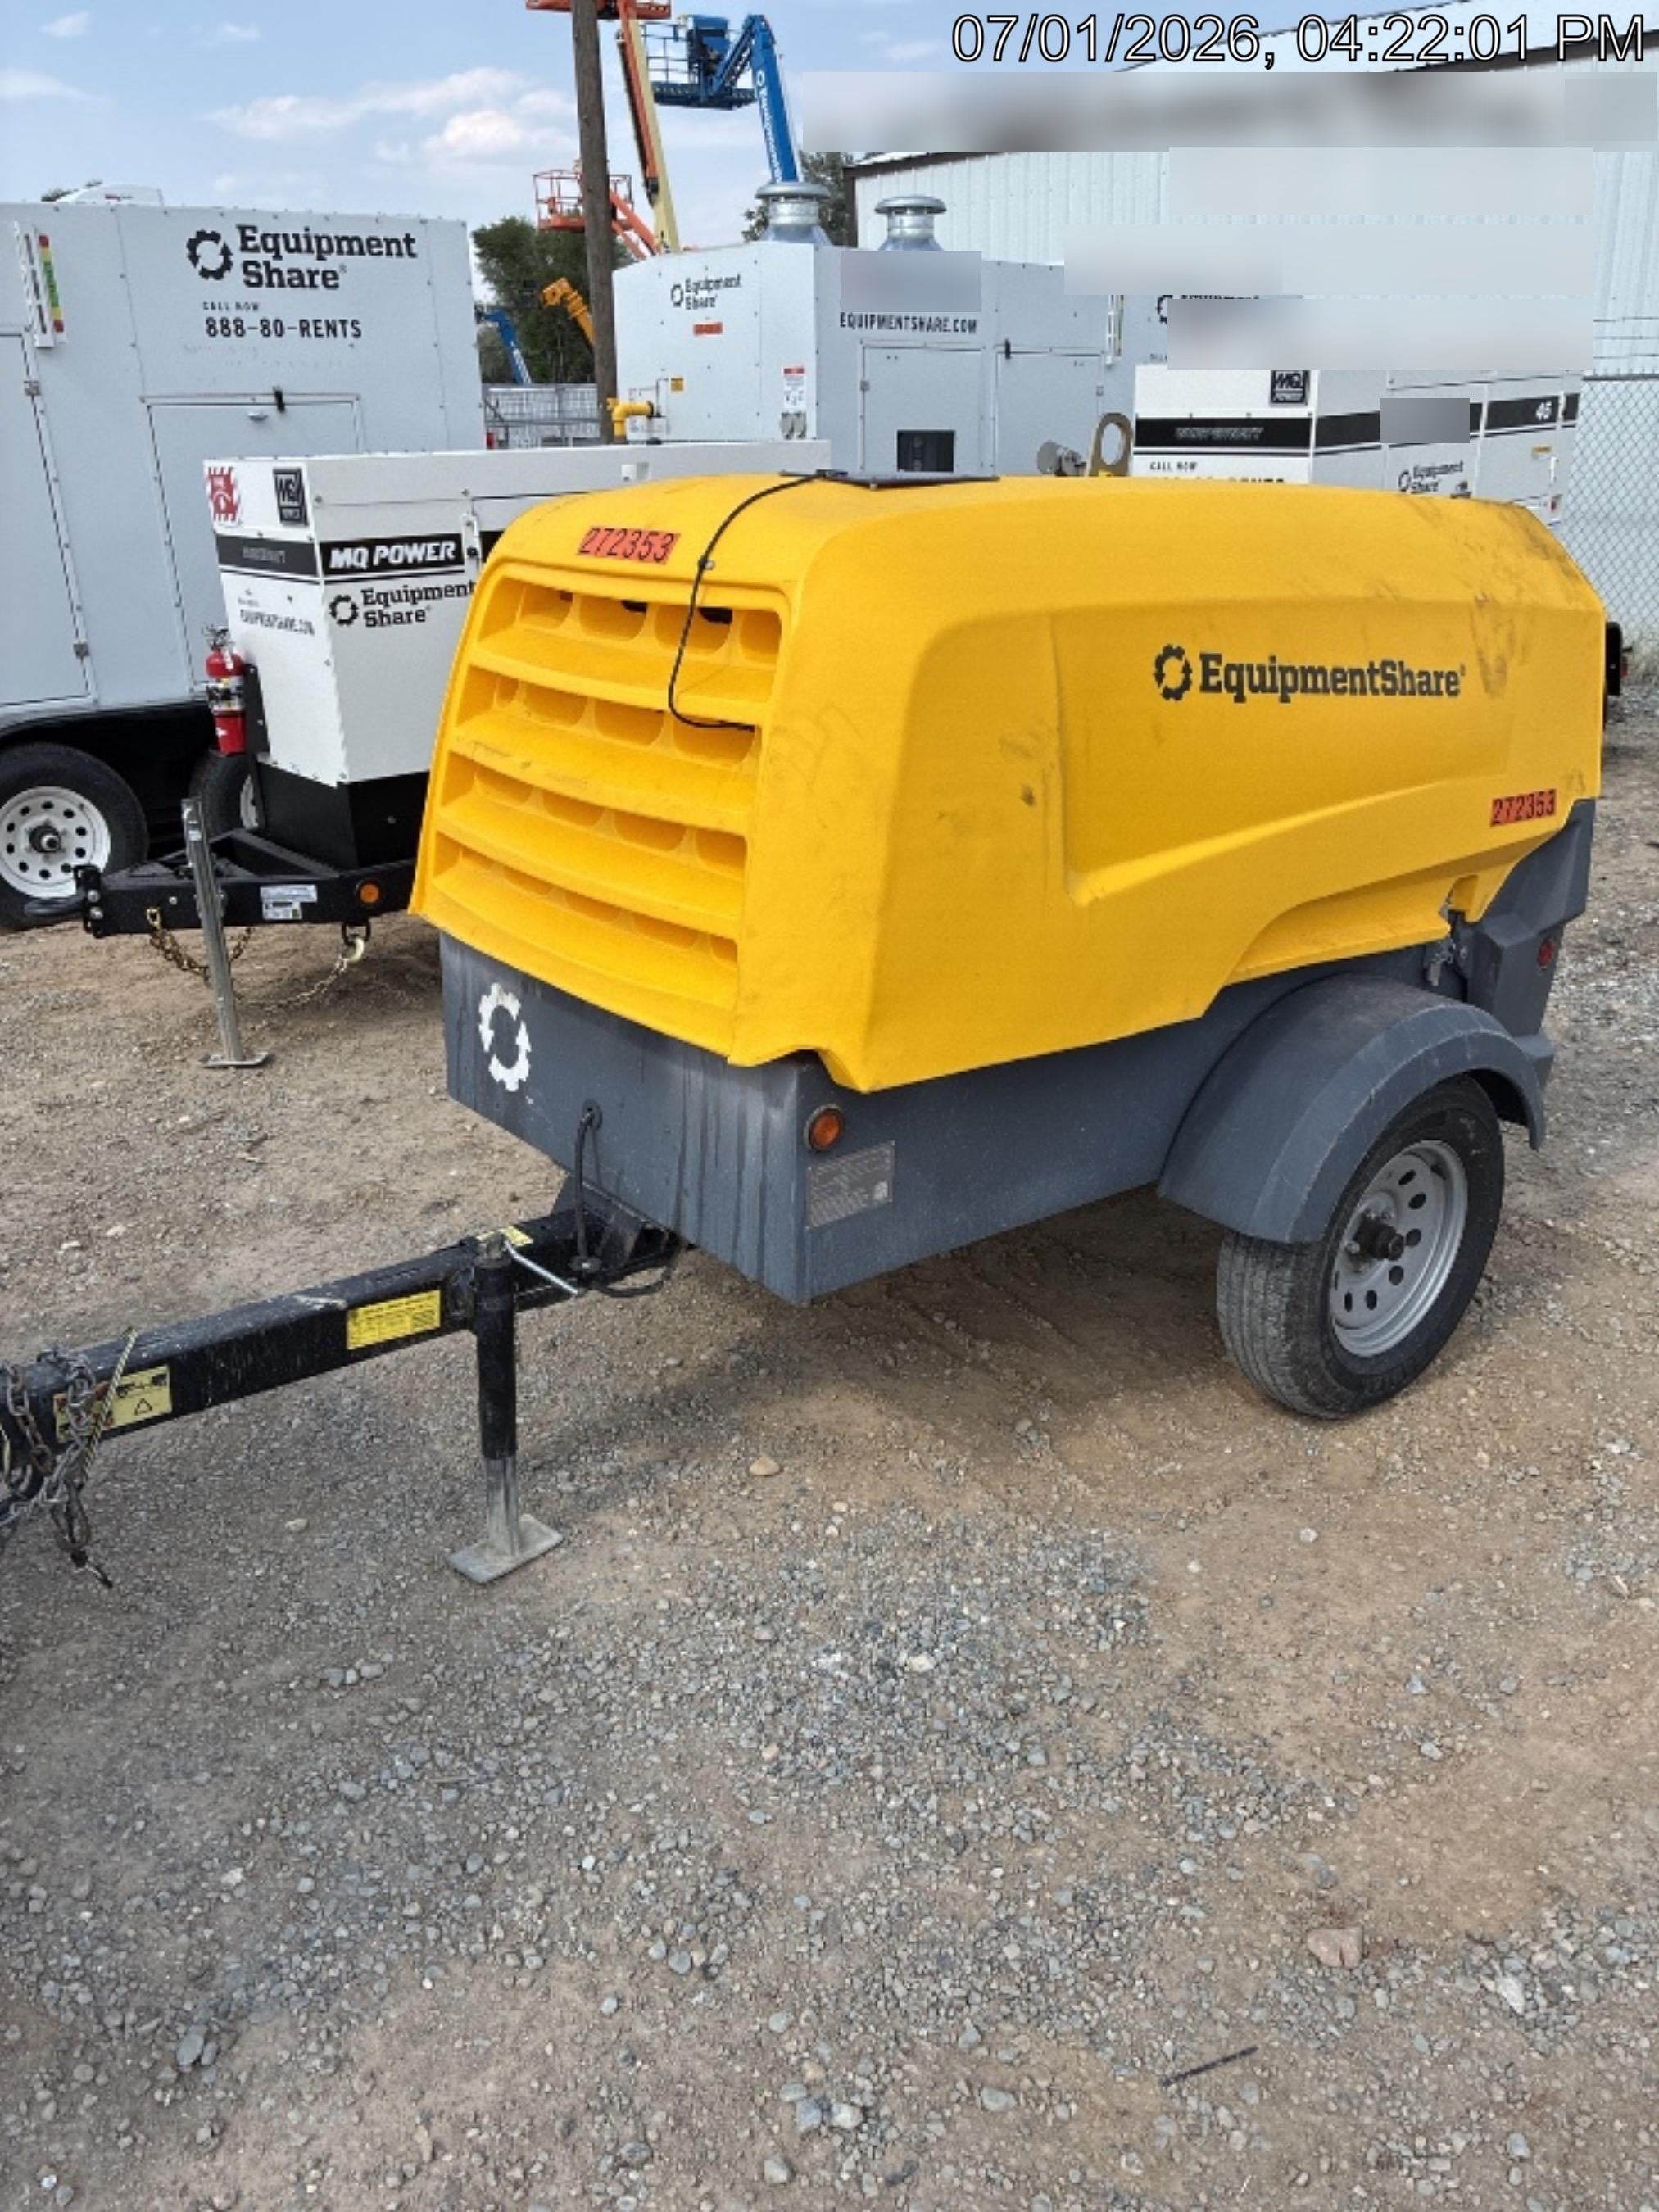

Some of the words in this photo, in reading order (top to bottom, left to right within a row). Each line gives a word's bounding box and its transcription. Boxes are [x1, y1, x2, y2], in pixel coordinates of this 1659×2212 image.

[236, 224, 417, 261] Equipment
[243, 260, 340, 290] Share
[206, 316, 362, 338] 888-80-RENTS
[329, 546, 369, 570] MQ
[372, 540, 456, 566] POWER
[578, 527, 675, 564] 272353
[360, 579, 474, 608] Equipment
[363, 608, 427, 628] Share
[1199, 652, 1461, 704] EquipmentShare
[1492, 789, 1556, 826] 272353
